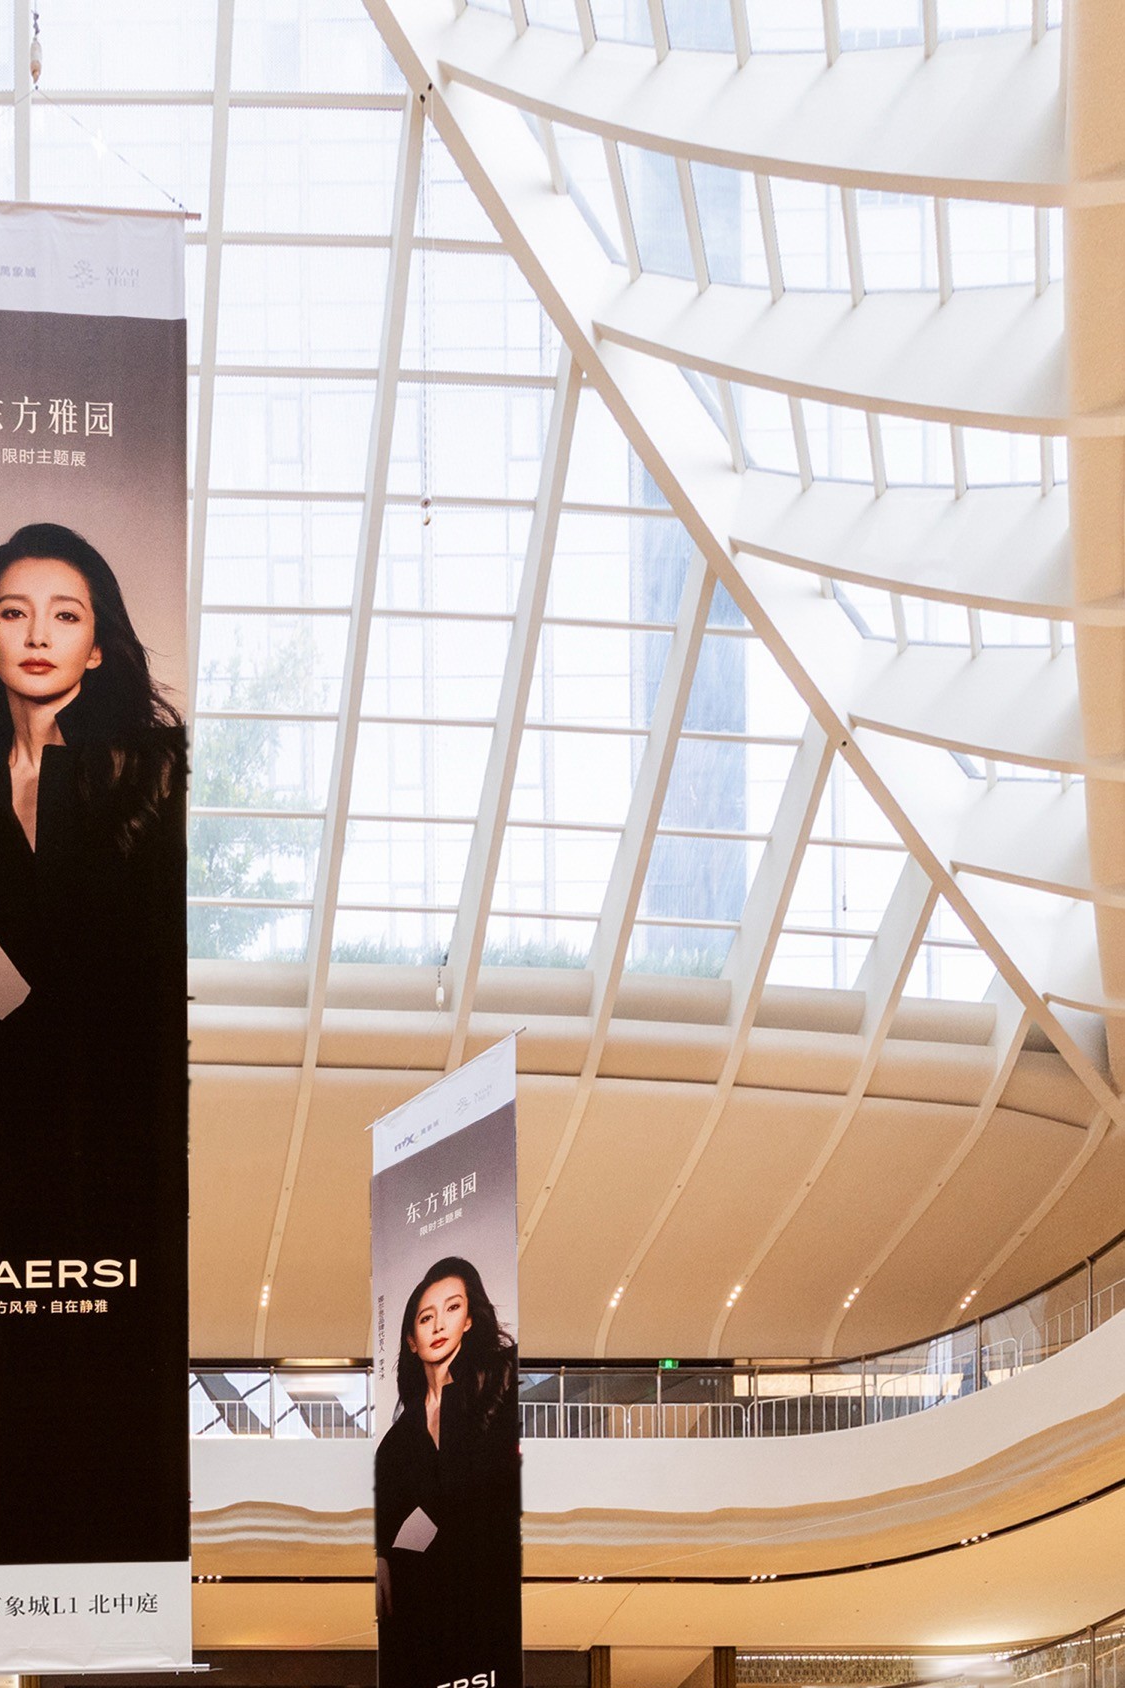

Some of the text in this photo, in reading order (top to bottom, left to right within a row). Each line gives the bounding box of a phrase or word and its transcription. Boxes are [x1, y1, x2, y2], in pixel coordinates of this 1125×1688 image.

[2, 448, 86, 467] 限时主题展
[406, 1172, 477, 1225] 东方雅园
[88, 1592, 159, 1615] 北中庭
